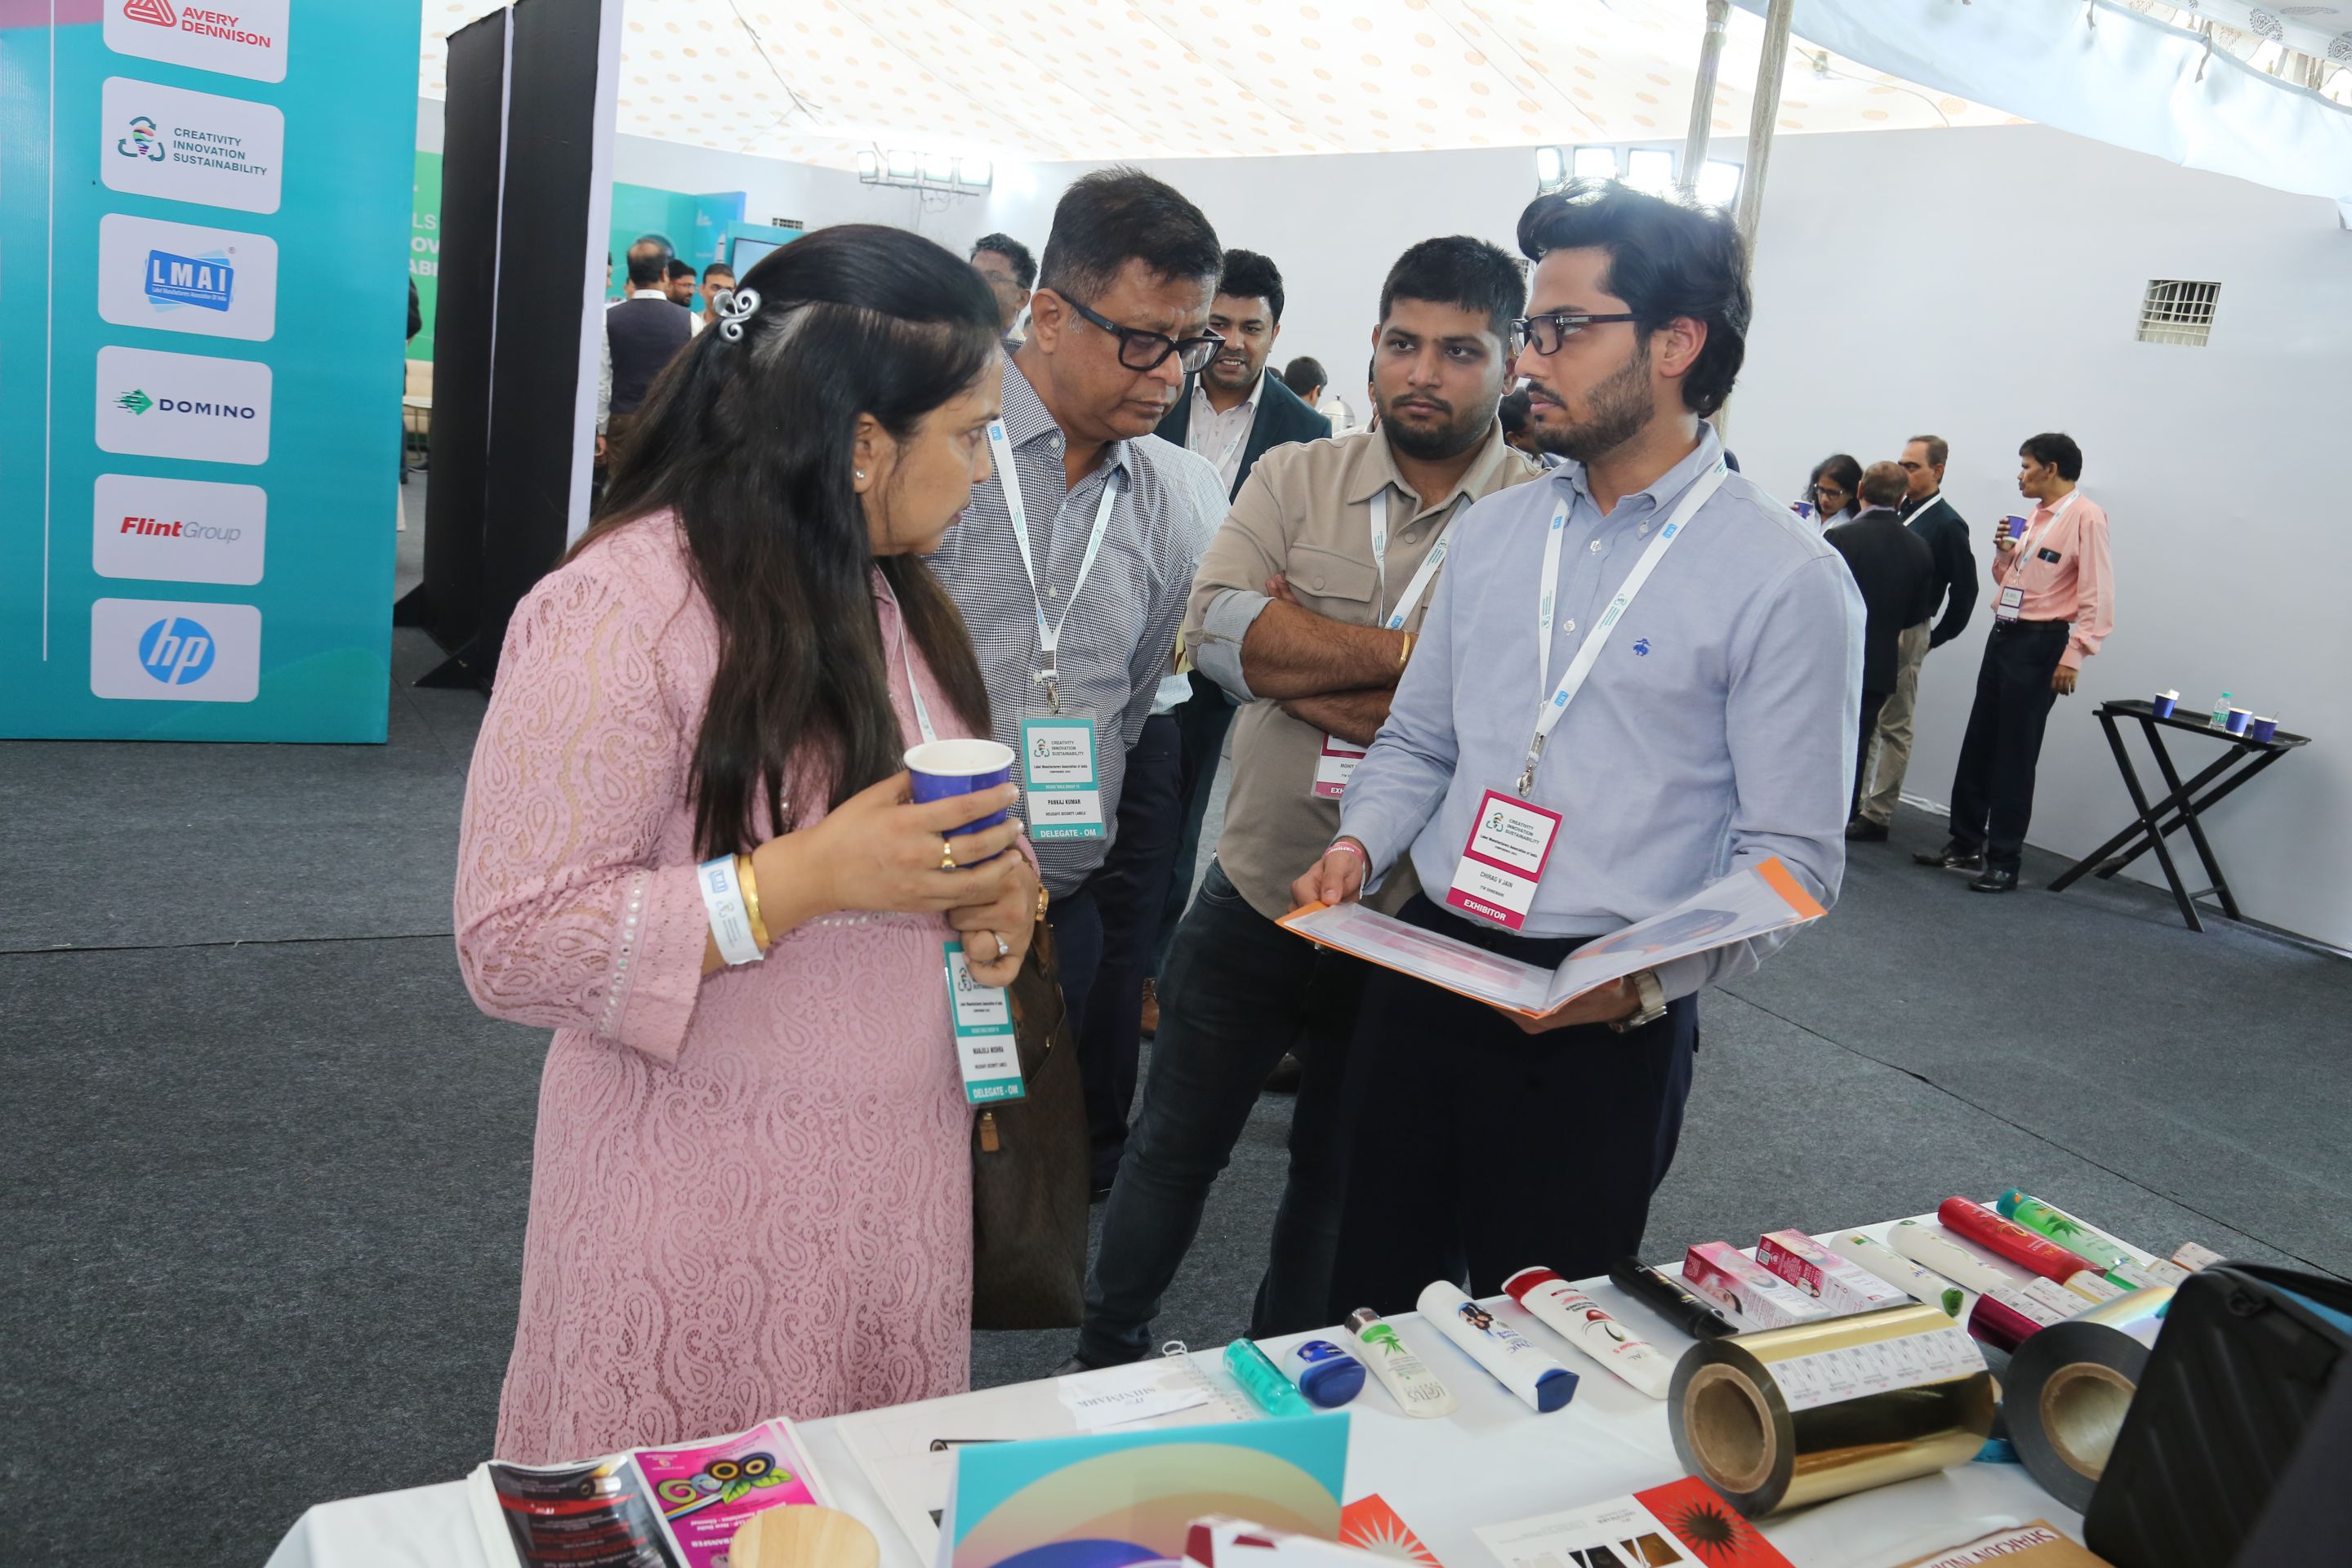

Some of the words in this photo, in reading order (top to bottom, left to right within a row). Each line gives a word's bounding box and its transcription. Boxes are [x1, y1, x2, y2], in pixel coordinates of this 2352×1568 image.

[182, 7, 239, 27] AVERY
[181, 20, 271, 48] DENNISON
[174, 127, 242, 146] CREATIVITY
[173, 140, 246, 160] INNOVATION
[173, 153, 267, 176] SUSTAINABILITY
[153, 259, 226, 292] LMAI
[159, 398, 256, 420] DOMINO
[145, 617, 211, 685] hp
[1040, 829, 1078, 838] DELEGATE
[1084, 828, 1096, 836] OM
[1507, 824, 1534, 836] INNOVATION
[1508, 818, 1535, 831] CREATIVITY
[1505, 829, 1539, 844] SUSTAINABILITY
[1480, 871, 1498, 883] CHIRAG
[1503, 880, 1513, 889] JAIN
[1463, 898, 1507, 921] EXHIBITOR
[973, 1085, 1004, 1098] DELEGATE
